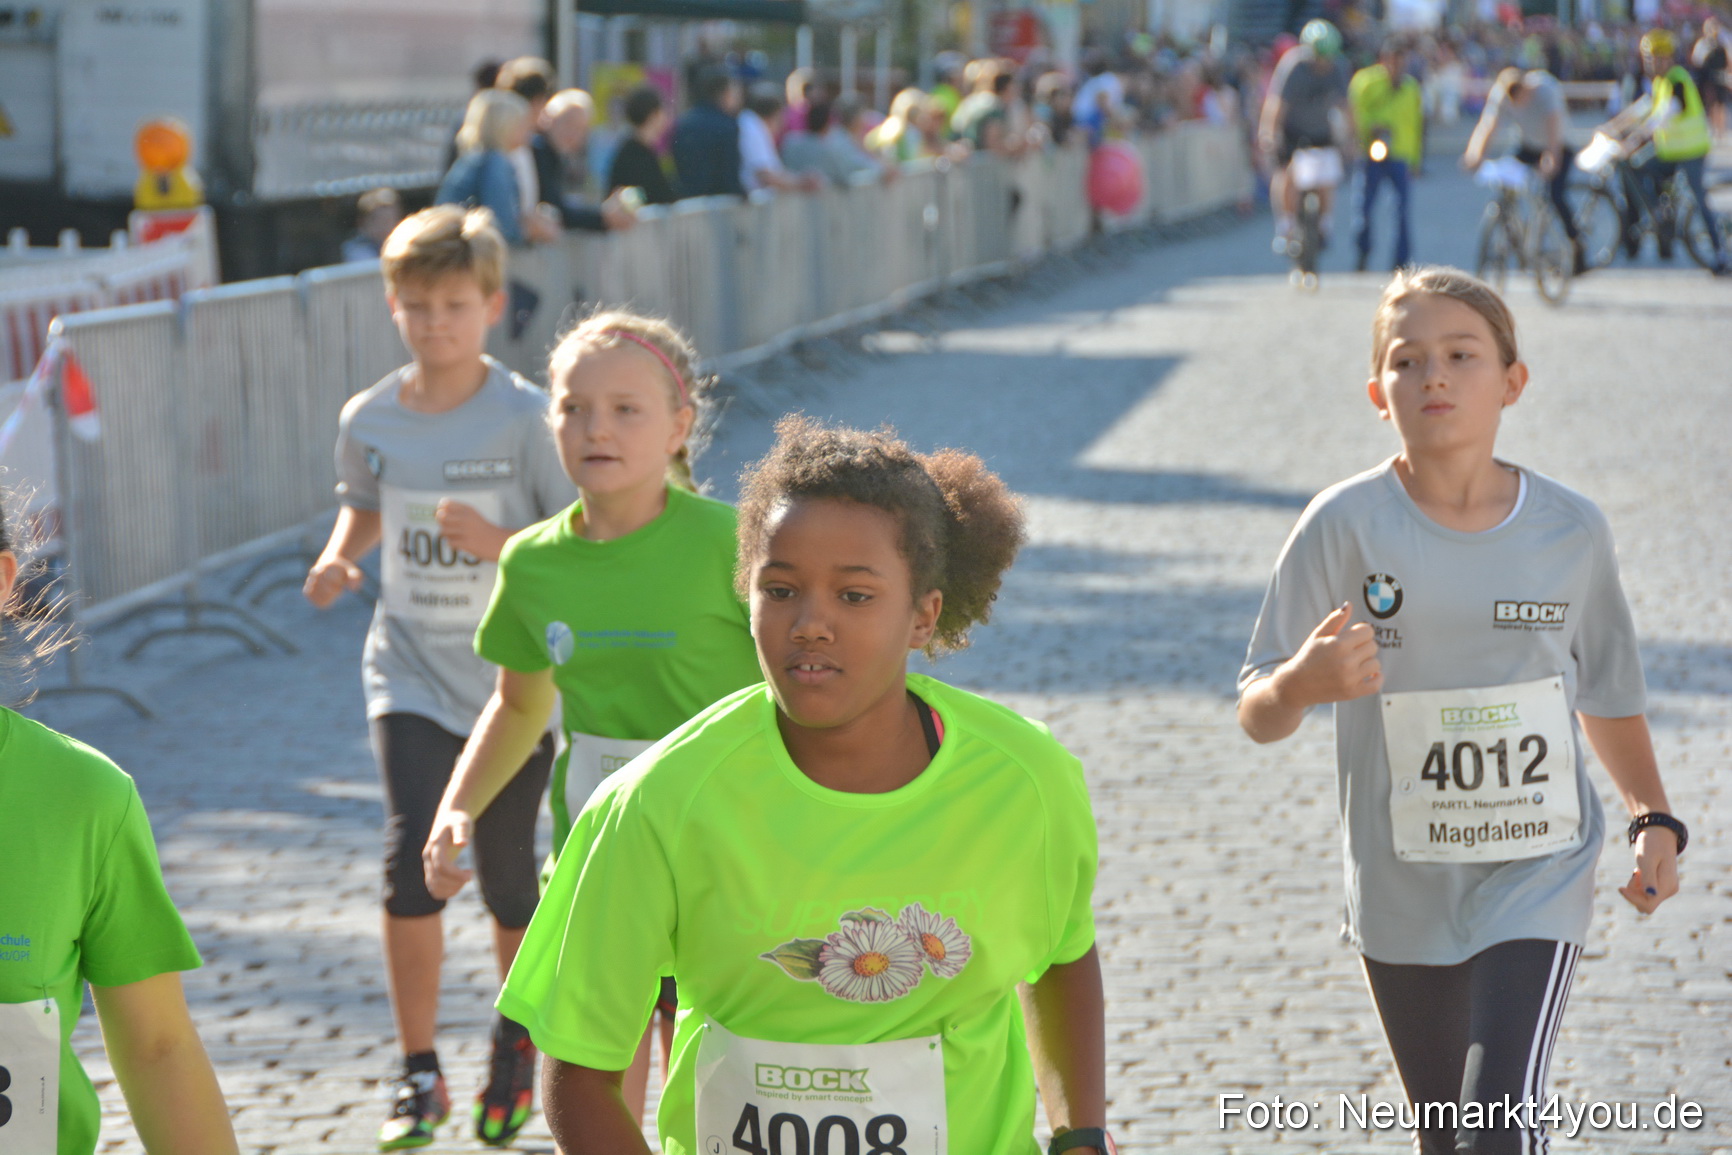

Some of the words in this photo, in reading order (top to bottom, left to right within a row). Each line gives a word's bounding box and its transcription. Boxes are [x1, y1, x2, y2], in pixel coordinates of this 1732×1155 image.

[1494, 600, 1569, 624] BOCK
[1441, 703, 1520, 726] BOCK
[1421, 734, 1550, 792] 4012
[1432, 800, 1472, 811] PARTL
[1474, 796, 1529, 809] Neumarkt
[1429, 819, 1550, 848] Magdalena
[0, 933, 31, 947] chule
[755, 1063, 872, 1093] BOCK
[756, 1087, 789, 1100] inspired
[791, 1092, 802, 1102] by
[805, 1093, 832, 1101] smart
[833, 1095, 874, 1104] concepts
[732, 1102, 908, 1155] 4008
